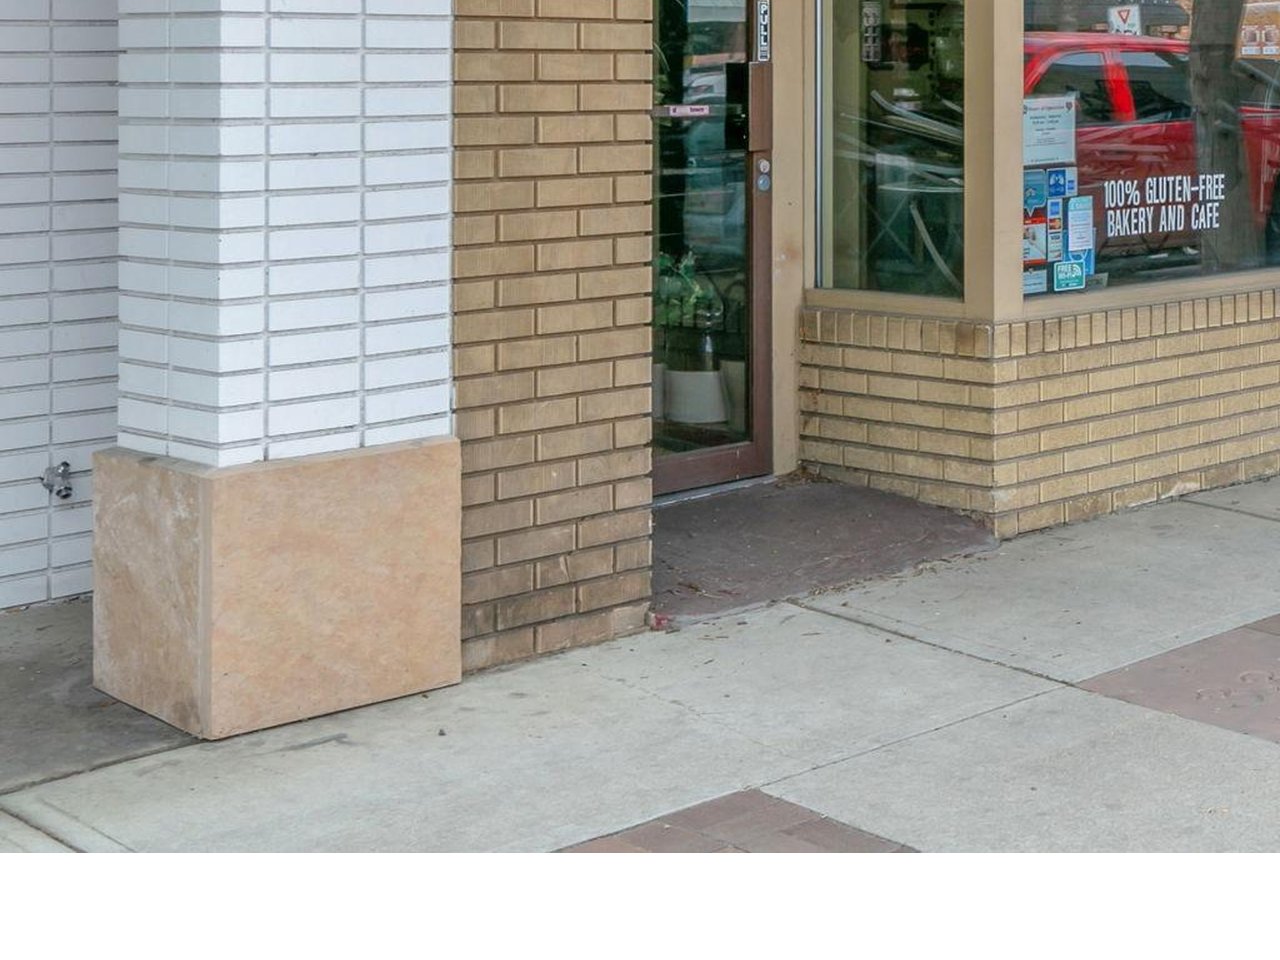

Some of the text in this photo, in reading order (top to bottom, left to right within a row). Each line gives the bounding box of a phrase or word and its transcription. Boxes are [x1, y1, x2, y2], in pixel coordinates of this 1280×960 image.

[759, 4, 769, 46] PULL
[1104, 174, 1226, 208] 100% GLUTEN-FREE
[1107, 206, 1154, 237] BAKERY
[1159, 204, 1185, 232] AND
[1191, 202, 1220, 229] CAFE
